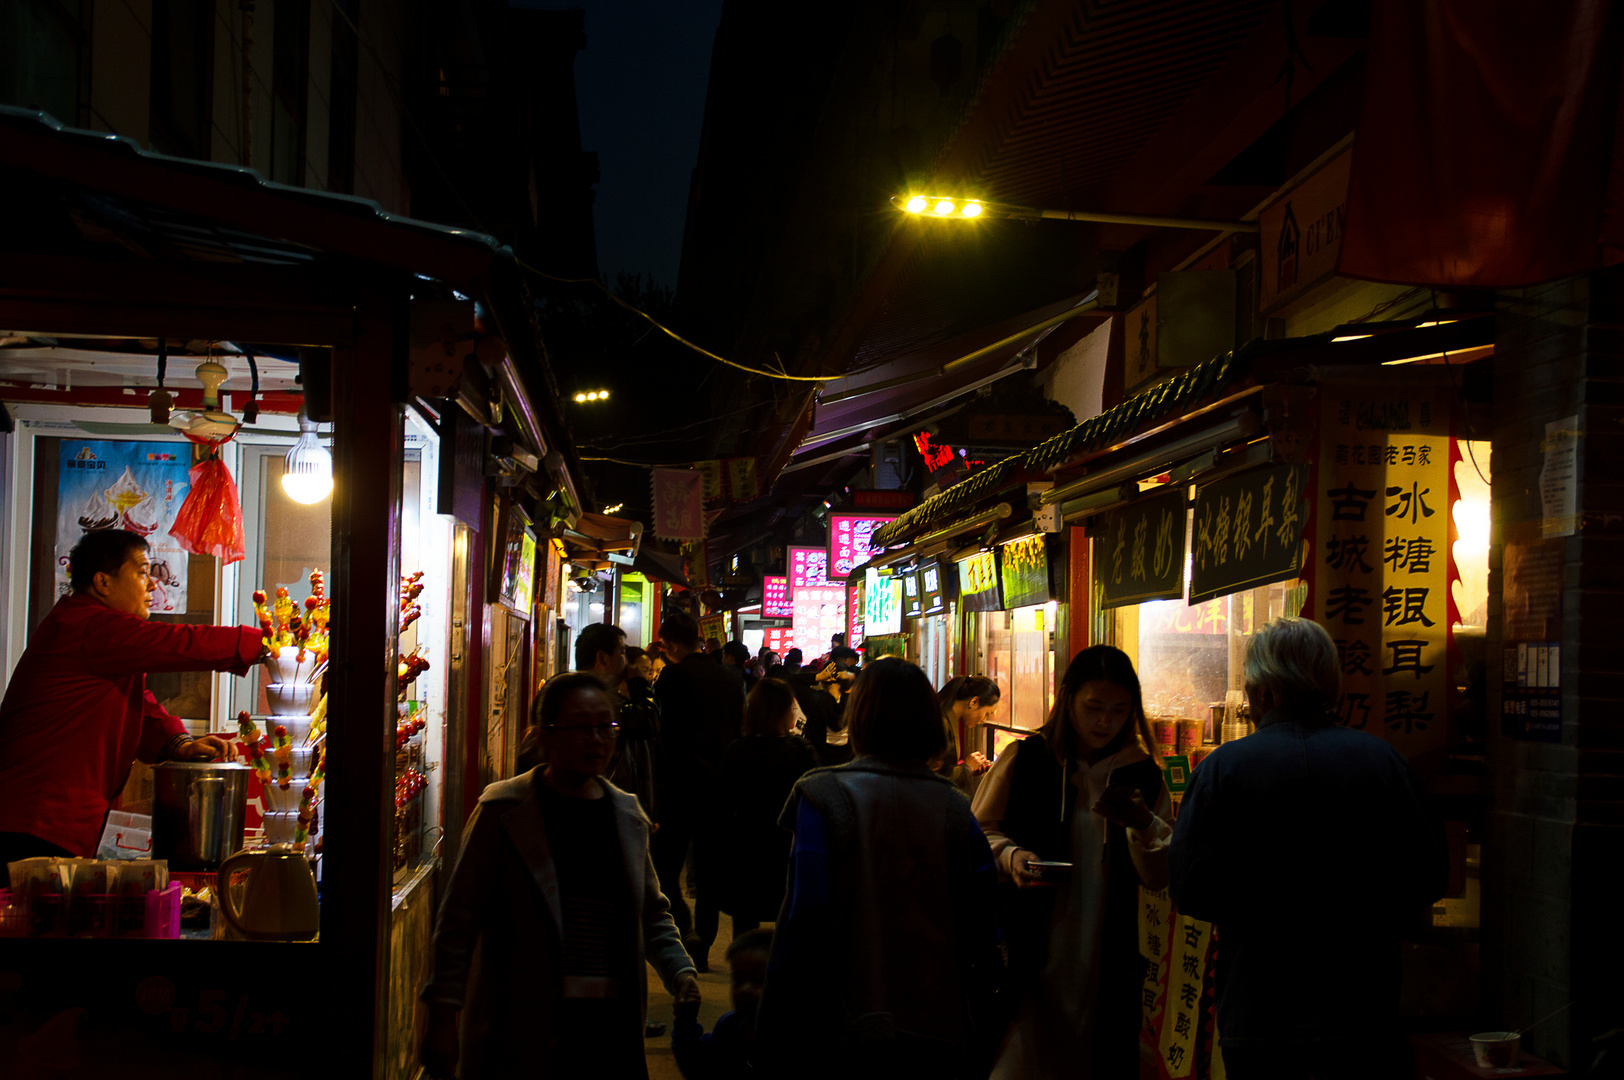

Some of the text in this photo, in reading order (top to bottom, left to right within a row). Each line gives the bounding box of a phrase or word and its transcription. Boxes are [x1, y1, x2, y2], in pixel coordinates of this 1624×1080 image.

[1325, 481, 1378, 730] 古城老酸奶
[1381, 480, 1436, 735] 冰糖银耳梨
[1167, 922, 1203, 1070] 古城老酸奶
